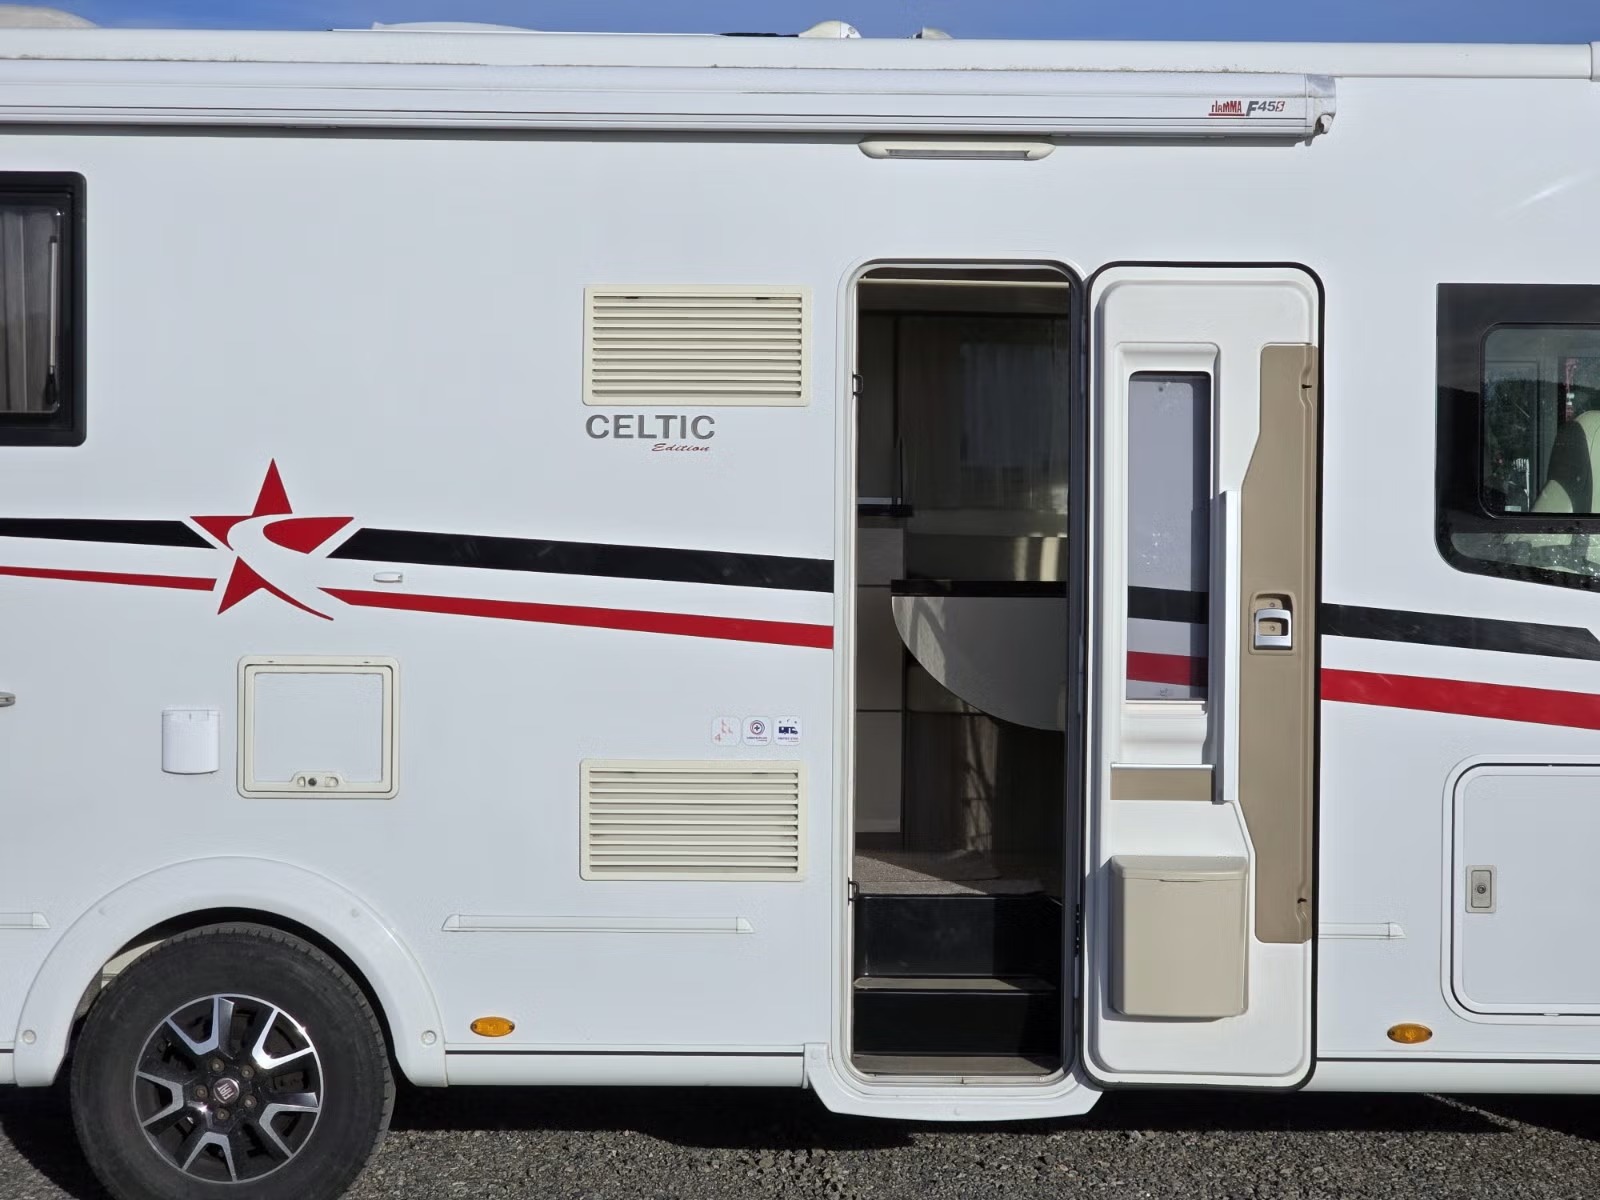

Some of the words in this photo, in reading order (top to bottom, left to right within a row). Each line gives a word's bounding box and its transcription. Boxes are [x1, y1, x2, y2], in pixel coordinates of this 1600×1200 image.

[585, 414, 715, 440] CELTIC
[651, 442, 710, 452] Edition
[217, 1083, 234, 1100] FIAT
